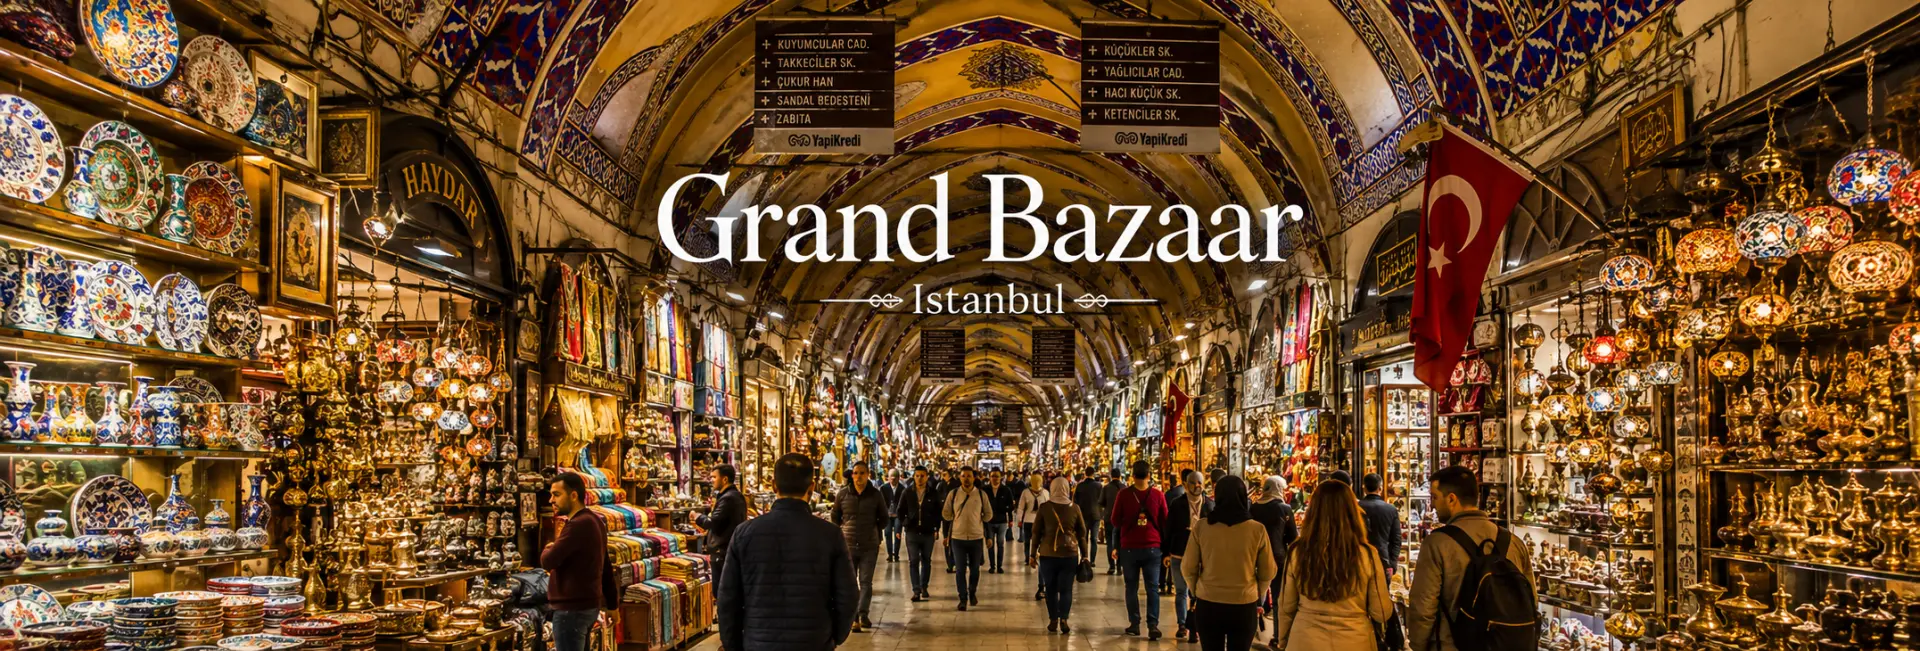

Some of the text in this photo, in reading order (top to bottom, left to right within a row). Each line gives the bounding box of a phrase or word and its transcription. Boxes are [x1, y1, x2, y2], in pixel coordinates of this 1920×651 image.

[777, 39, 869, 50] KUYUMCULAR CAD.
[1104, 43, 1174, 58] KÜÇÜKLER SK.
[777, 54, 856, 68] TAKKECİLER SK.
[1104, 64, 1185, 79] YAĞLICILAR CAD.
[777, 76, 834, 89] ÇUKUR HAN
[776, 93, 871, 106] SANDAL BEDESTENİ
[1104, 85, 1181, 101] HACI KÜÇÜK SK.
[776, 113, 812, 124] ZABITA
[1104, 106, 1180, 121] KETENCİLER SK.
[402, 162, 479, 230] HAYDAR
